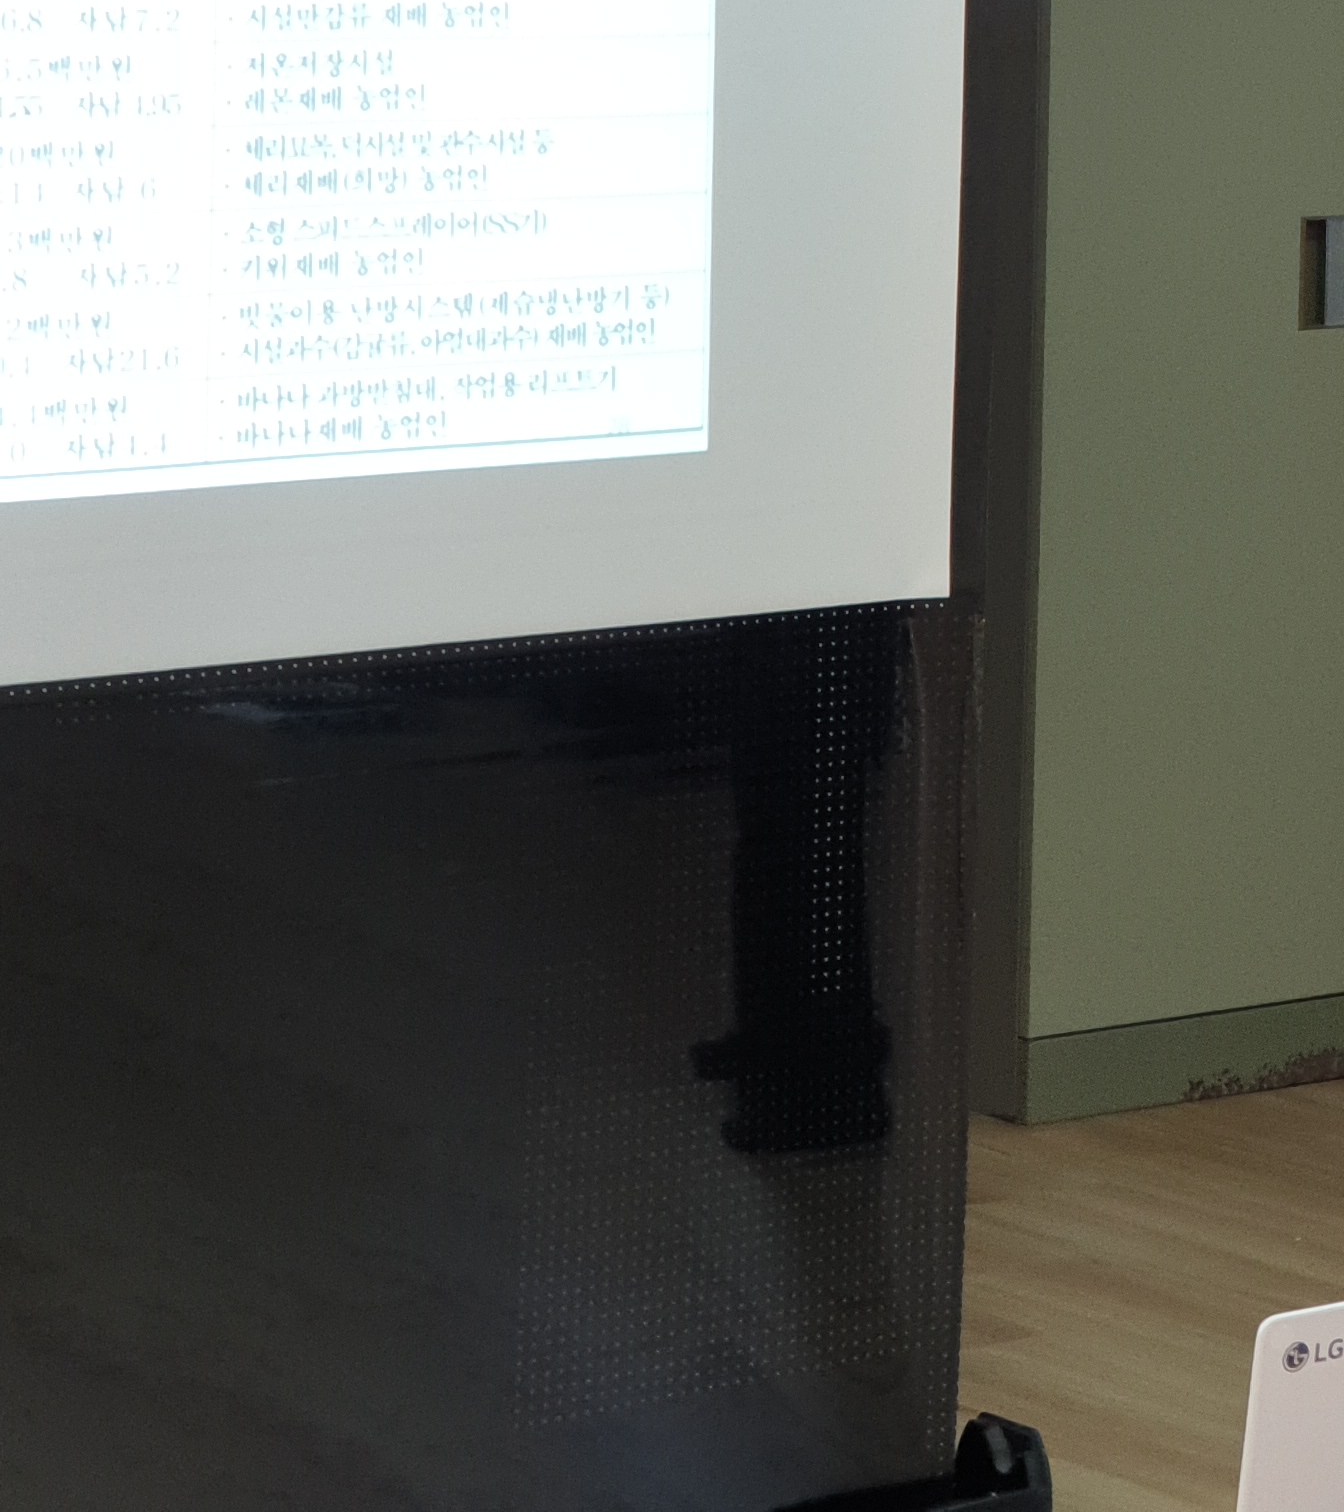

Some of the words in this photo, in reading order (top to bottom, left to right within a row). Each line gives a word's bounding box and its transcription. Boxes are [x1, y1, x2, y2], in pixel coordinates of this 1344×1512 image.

[442, 2, 508, 28] 농업인
[358, 84, 424, 111] 농업인
[421, 164, 486, 192] 농업인
[355, 248, 422, 276] 농업인
[596, 318, 654, 347] 농업인
[379, 411, 445, 440] 농업인
[1313, 1337, 1344, 1364] LG
